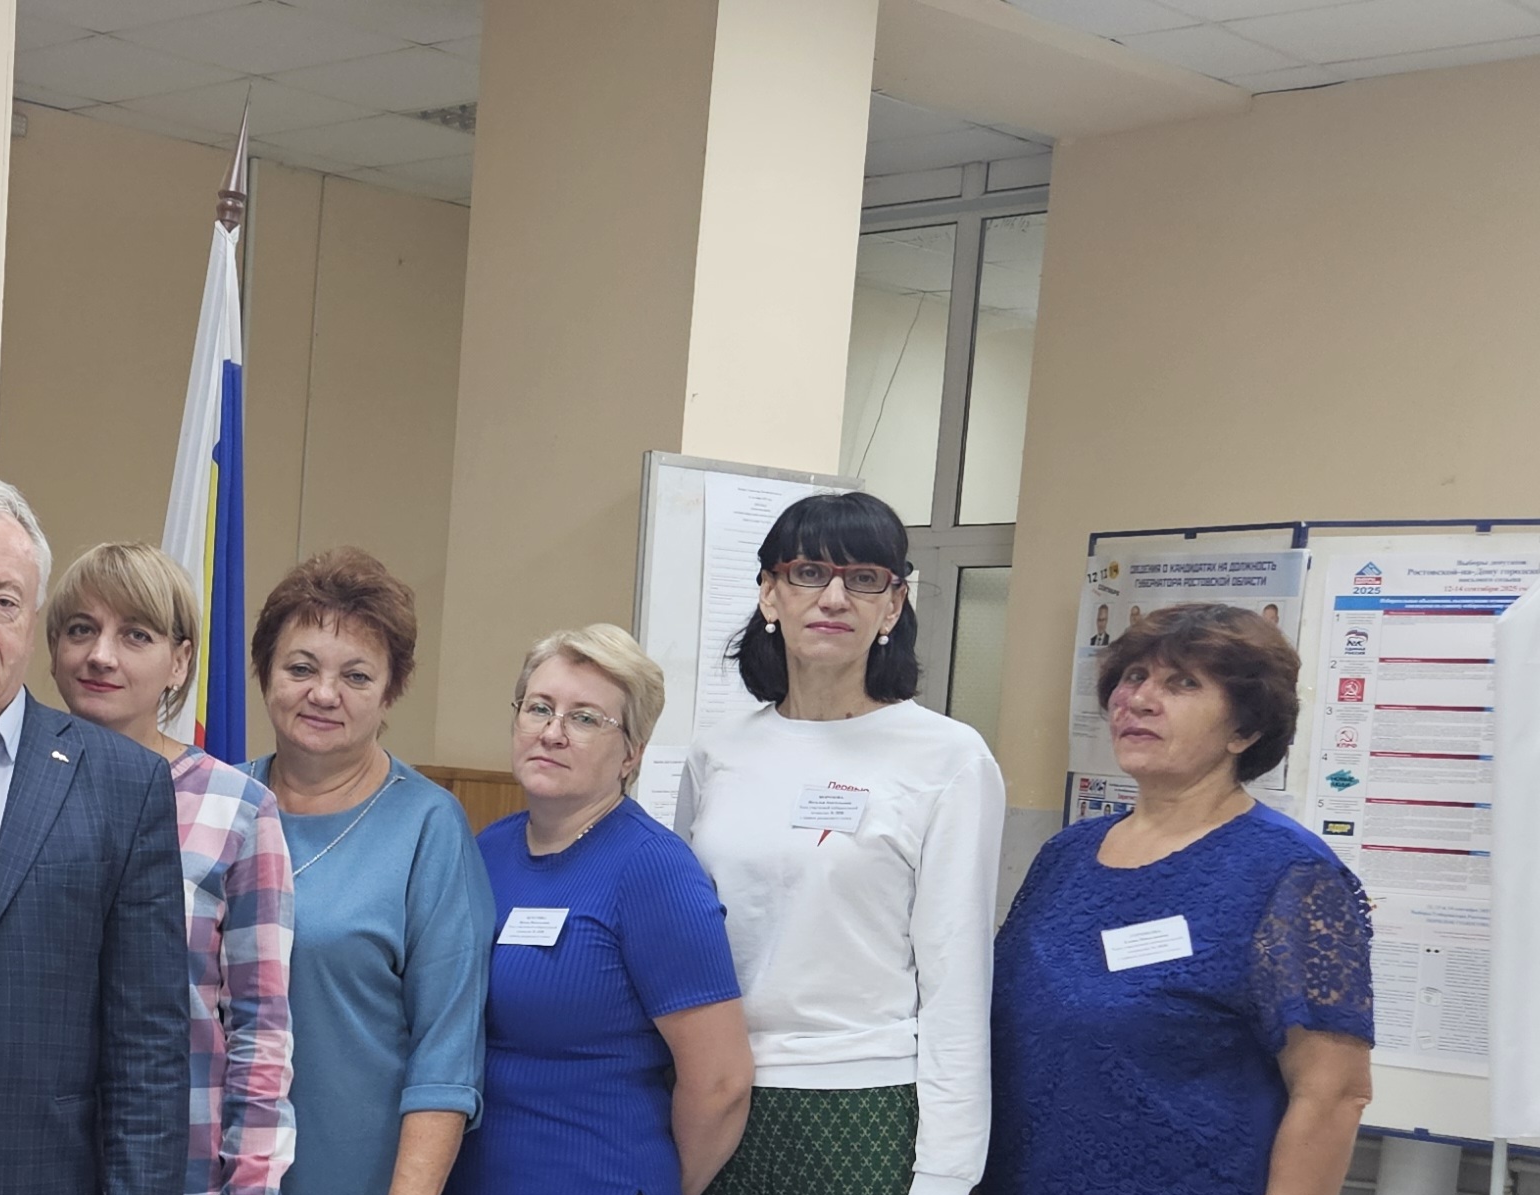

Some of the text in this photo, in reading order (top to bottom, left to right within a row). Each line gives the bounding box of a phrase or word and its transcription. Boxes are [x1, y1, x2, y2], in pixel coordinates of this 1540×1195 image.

[1353, 586, 1381, 595] 2025
[1330, 660, 1337, 669] 2
[1326, 706, 1333, 716] 3
[1321, 753, 1328, 761] 4
[1317, 799, 1325, 808] 5
